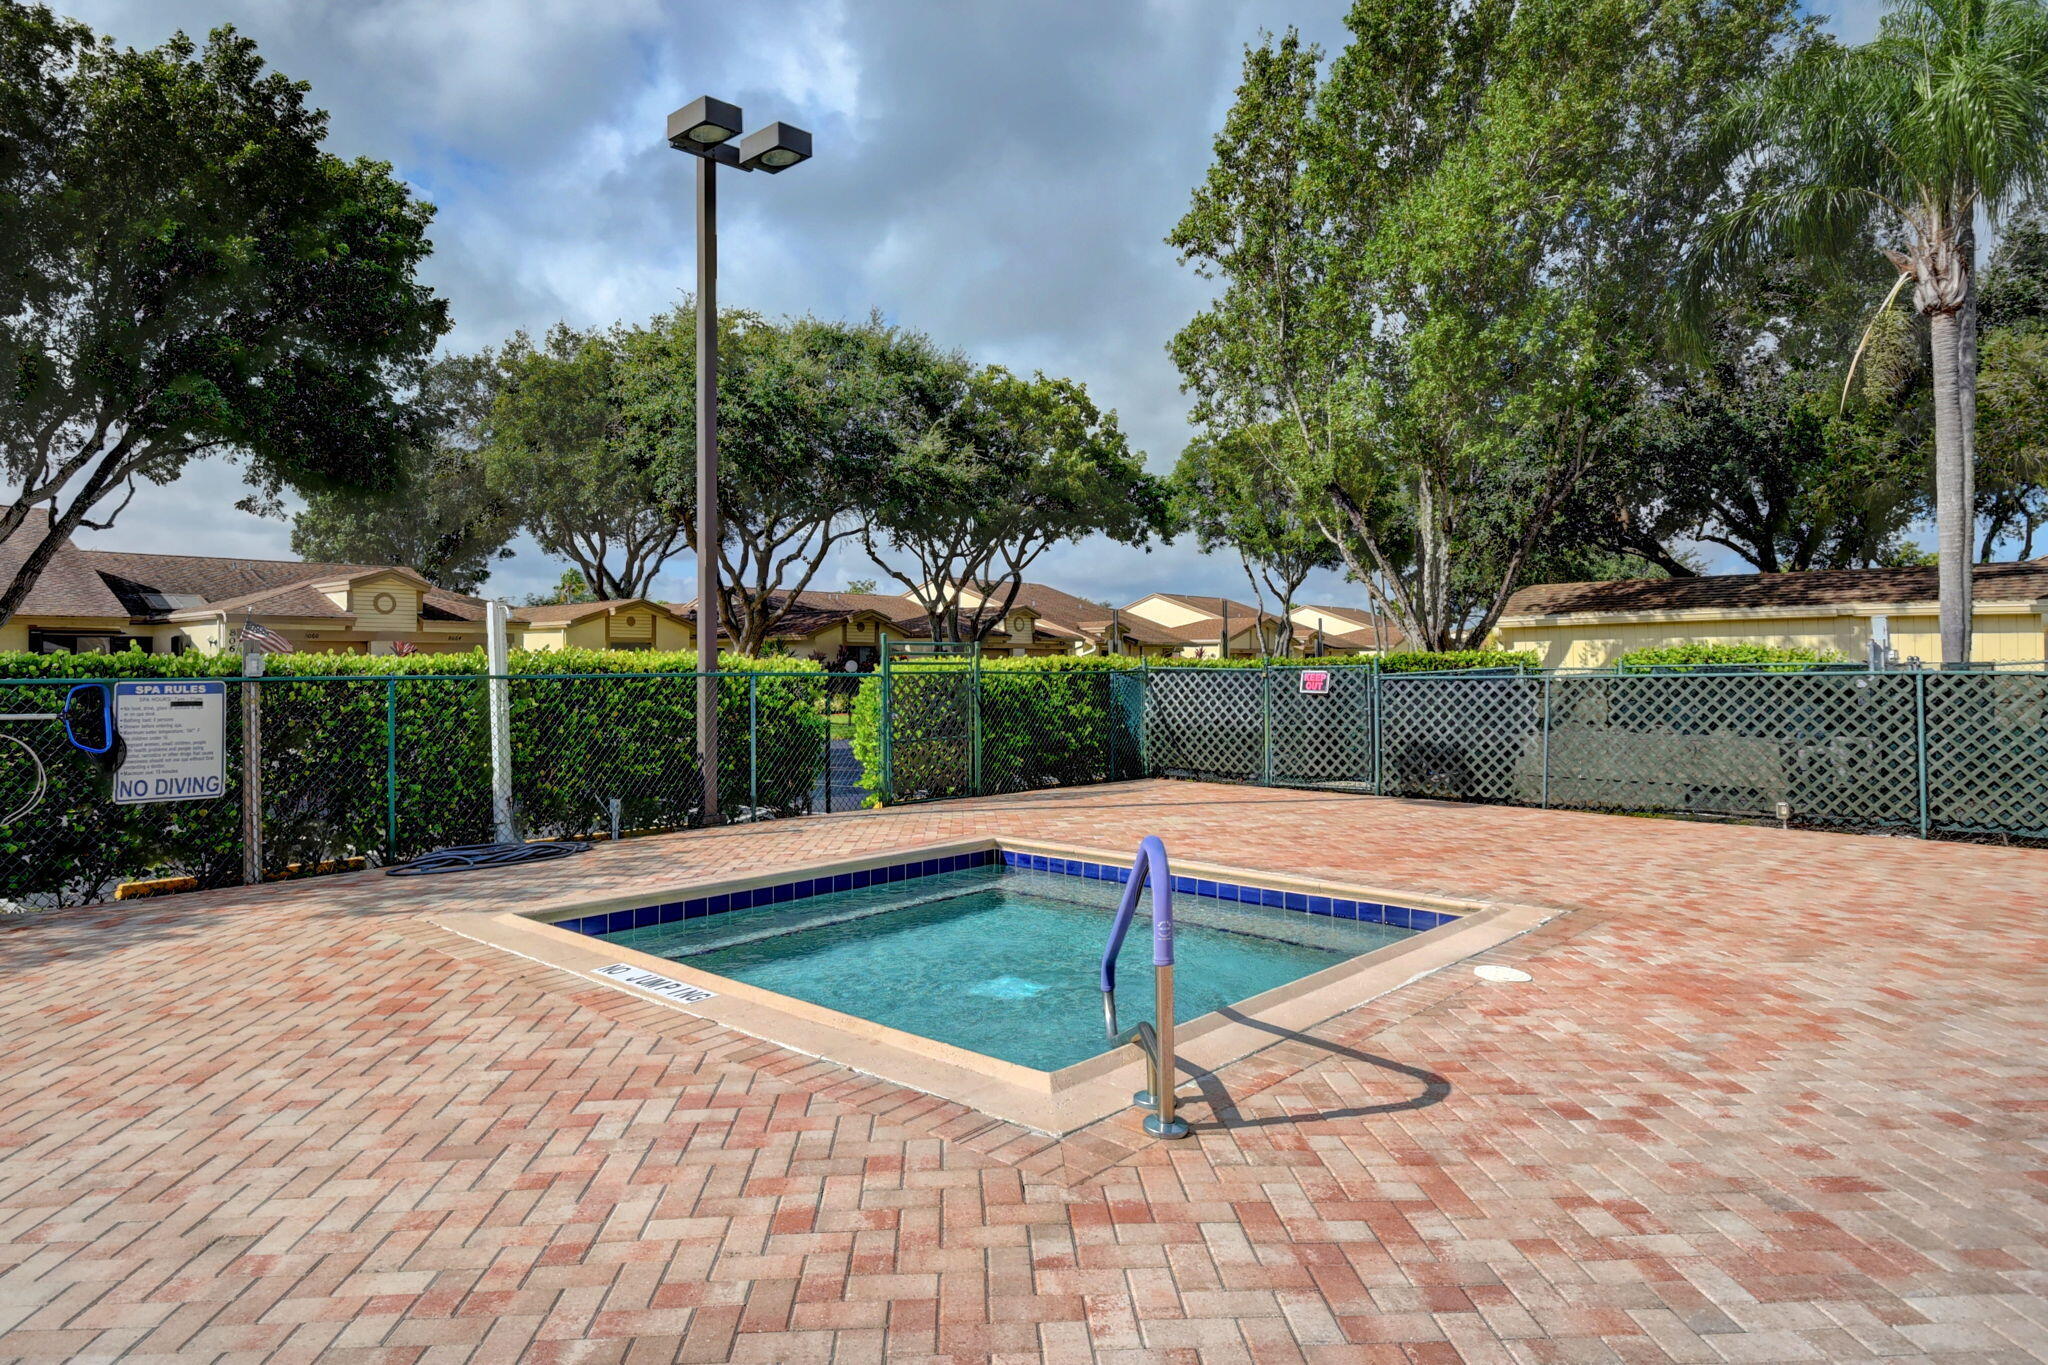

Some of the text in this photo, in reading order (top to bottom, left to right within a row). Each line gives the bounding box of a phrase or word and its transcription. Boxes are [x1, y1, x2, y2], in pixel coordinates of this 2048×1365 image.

[1304, 673, 1327, 681] KEEP
[135, 684, 206, 694] SPA RULES
[1305, 681, 1323, 690] OUT
[120, 775, 219, 797] NO DIVING
[597, 964, 711, 1001] NO JUMPING
